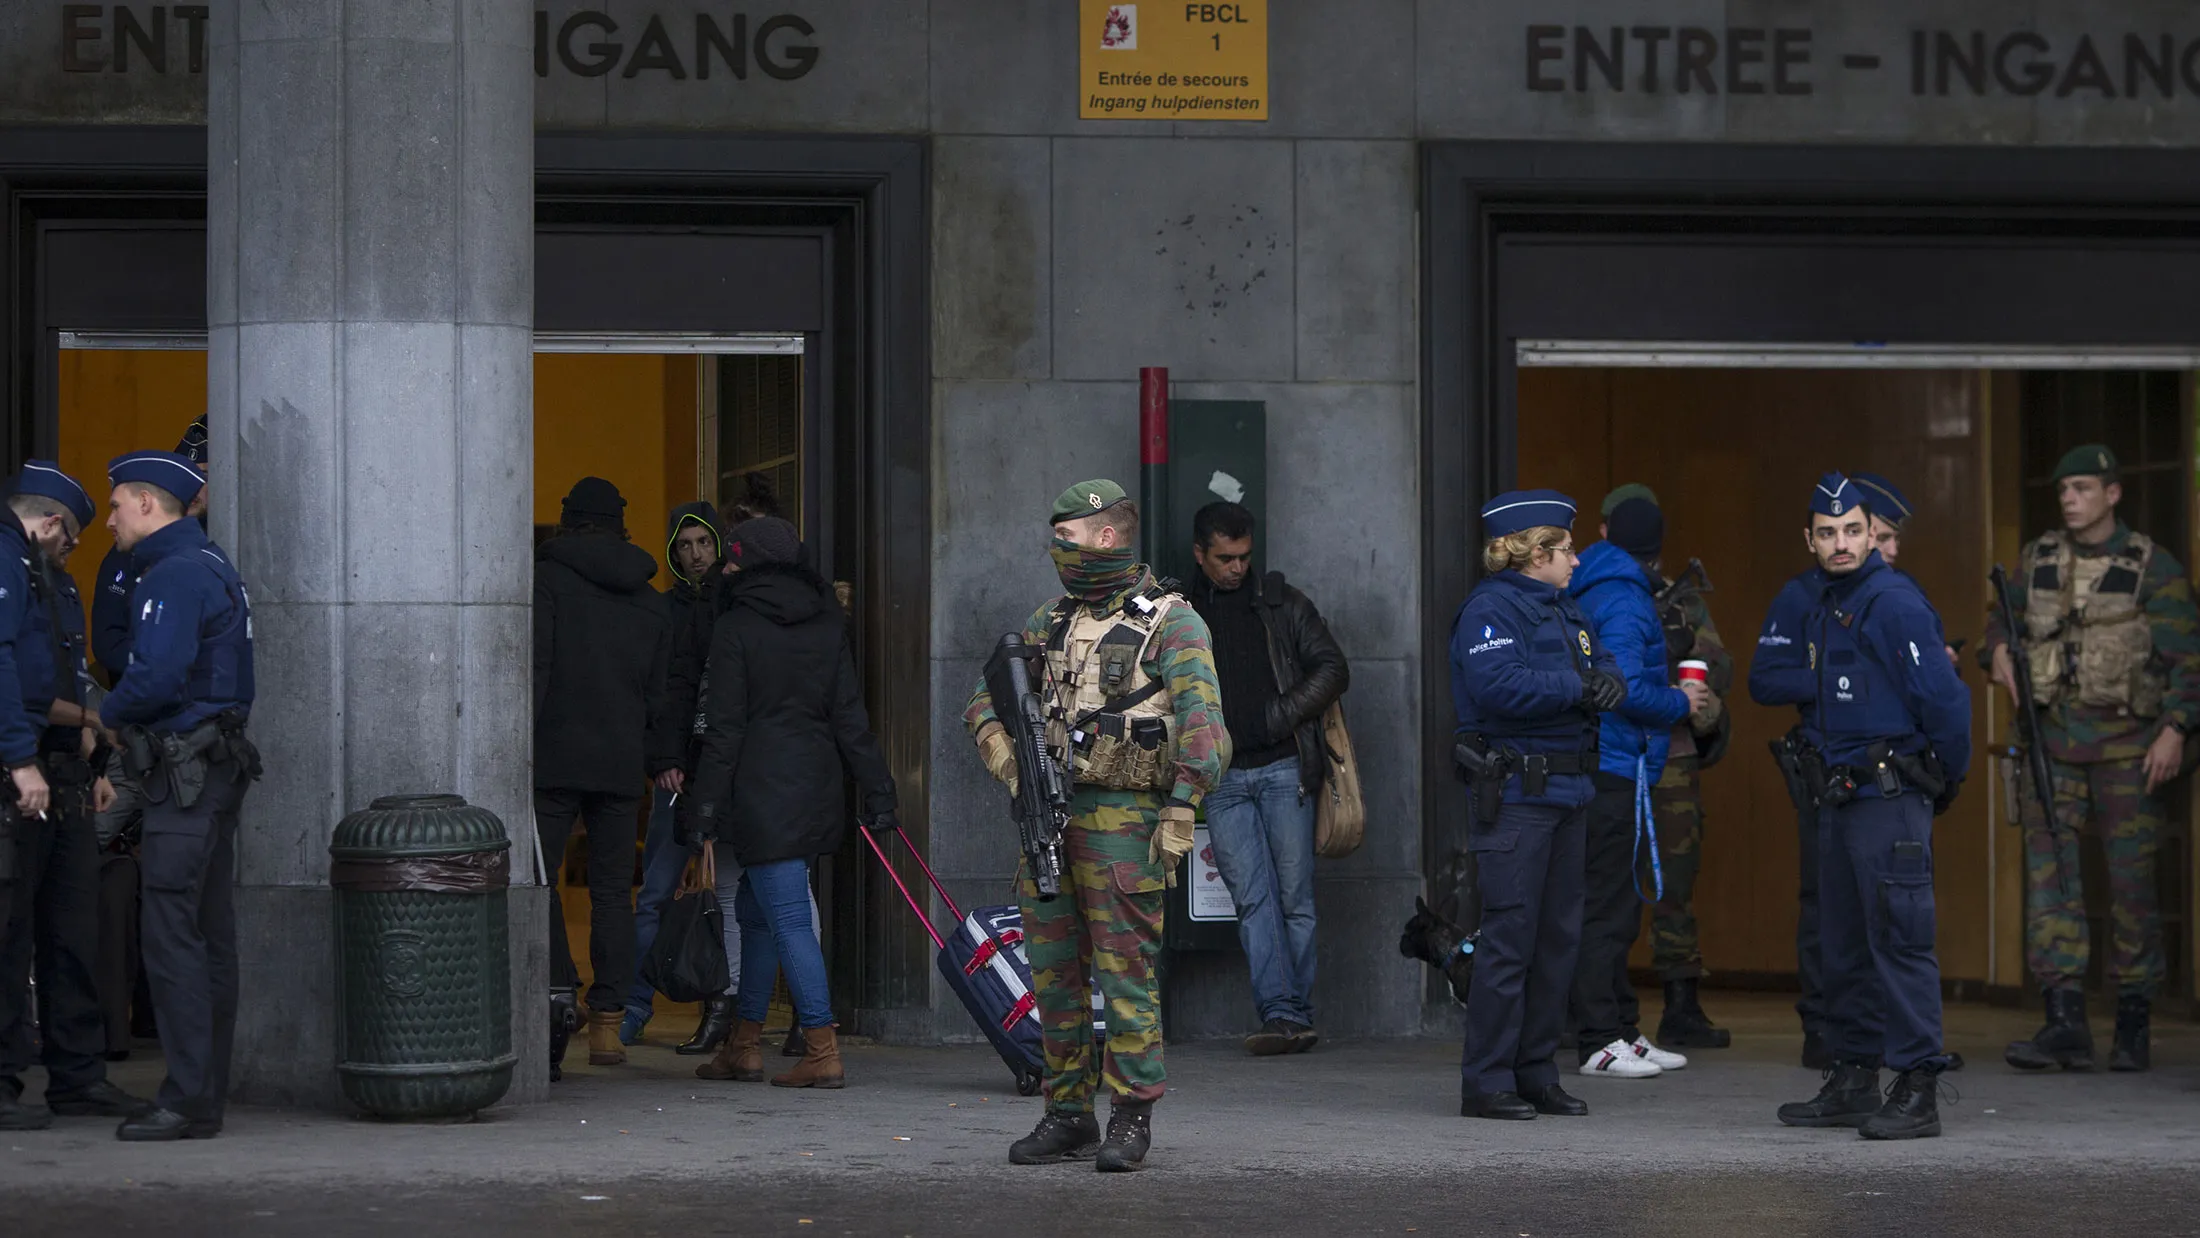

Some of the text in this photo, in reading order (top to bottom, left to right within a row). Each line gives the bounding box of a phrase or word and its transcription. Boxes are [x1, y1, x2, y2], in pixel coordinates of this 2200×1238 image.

[1186, 4, 1248, 23] FBCL
[534, 10, 819, 81] GANG
[1211, 33, 1220, 51] 1
[1527, 24, 1813, 95] ENTREE
[1098, 71, 1248, 87] Entrée de secours
[1089, 94, 1260, 112] Ingang hulpdiensten
